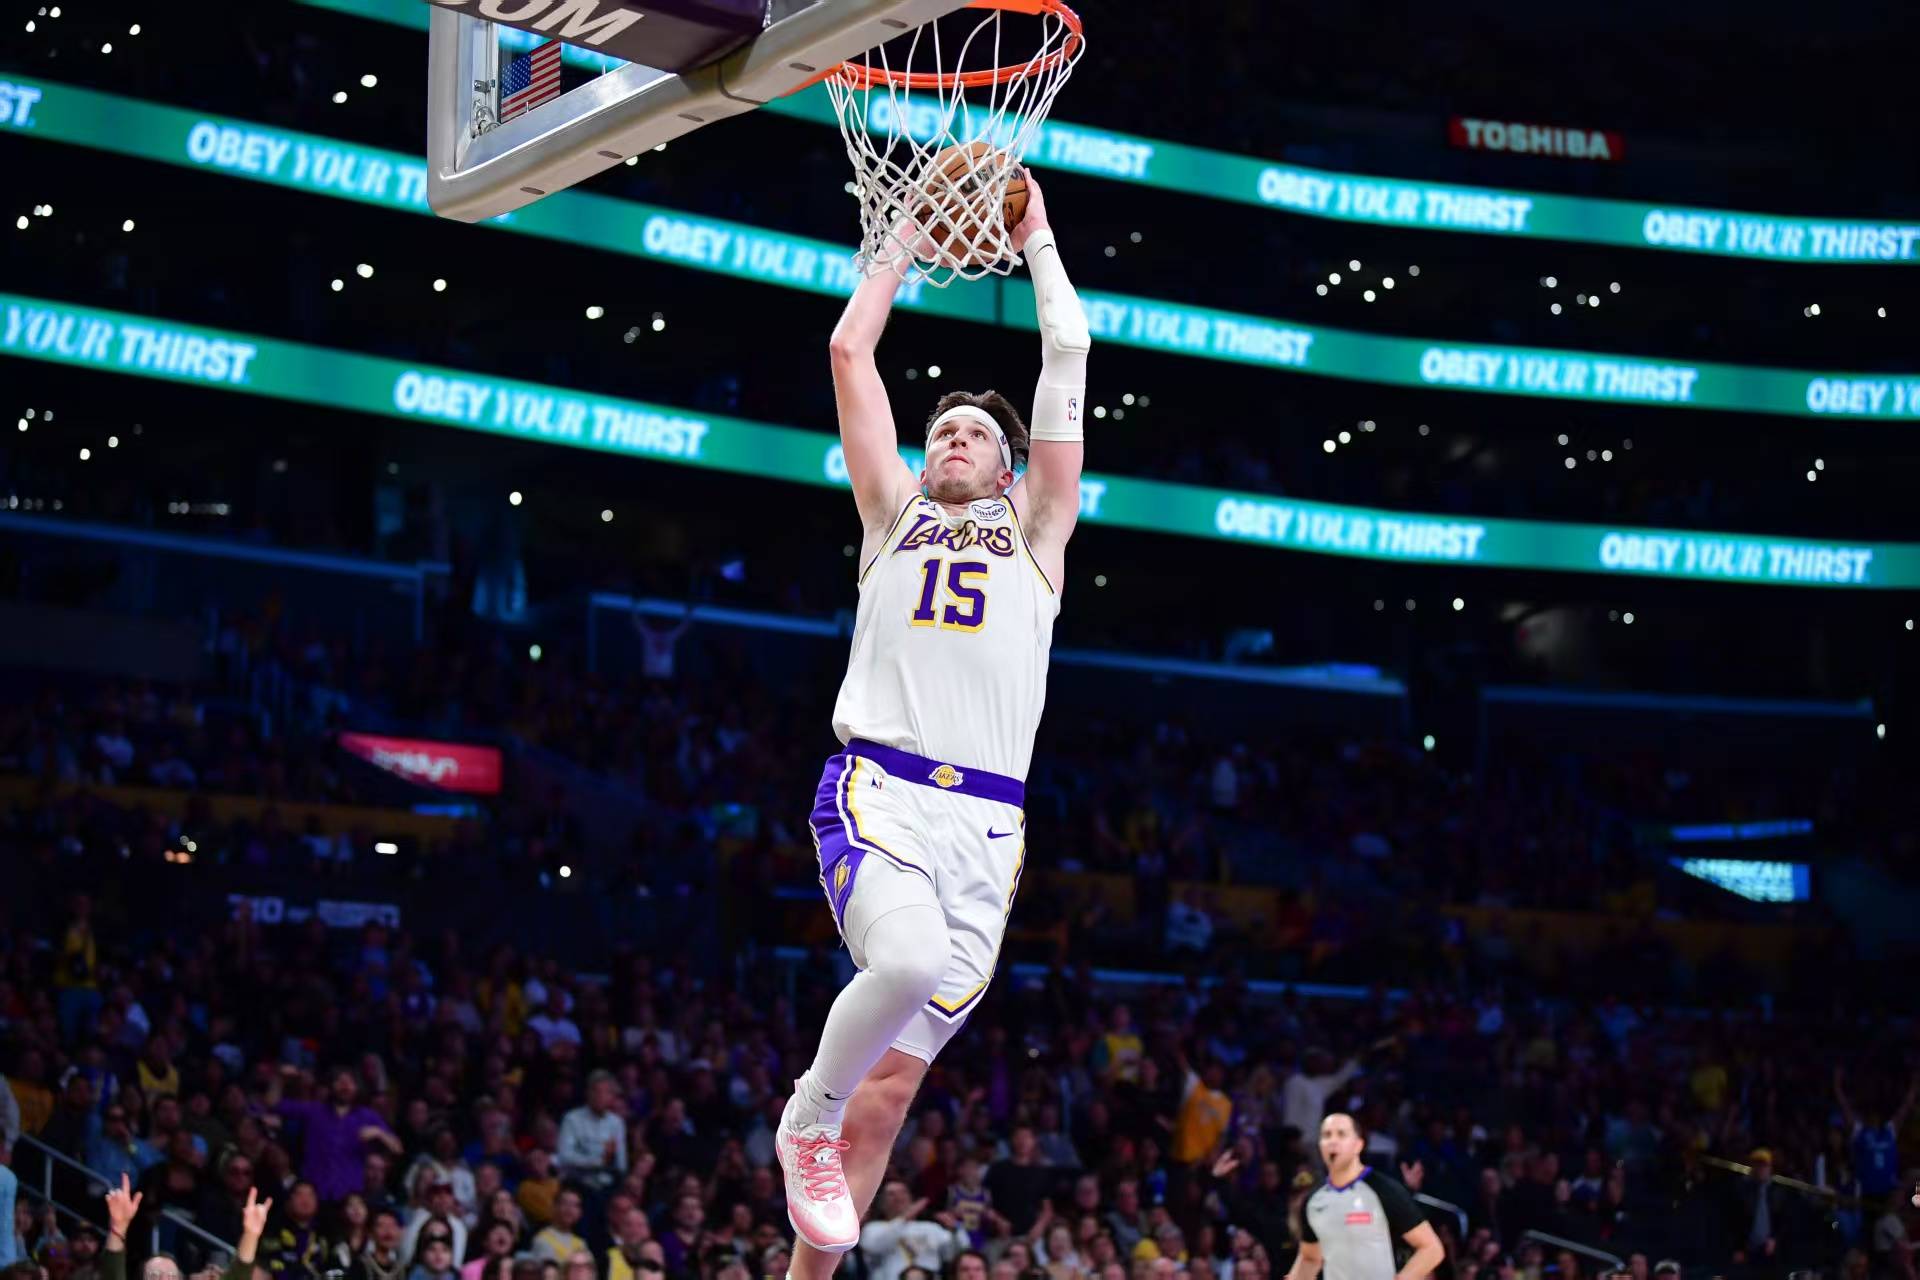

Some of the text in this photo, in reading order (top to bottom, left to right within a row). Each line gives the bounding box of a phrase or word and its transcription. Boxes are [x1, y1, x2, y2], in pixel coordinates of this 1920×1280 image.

[187, 121, 290, 176] OBEY
[1461, 118, 1612, 160] TOSHIBA
[1257, 167, 1334, 209] OBEY
[642, 214, 729, 265] OBEY
[1643, 209, 1721, 248] OBEY
[3, 303, 114, 362] YOUR
[1420, 347, 1504, 386] OBEY
[394, 370, 490, 421] OBEY
[1806, 377, 1889, 414] OBEY
[893, 514, 1014, 557] LAKERS
[1215, 497, 1294, 541] OBEY
[1600, 531, 1682, 572] OBEY
[911, 557, 990, 633] 15
